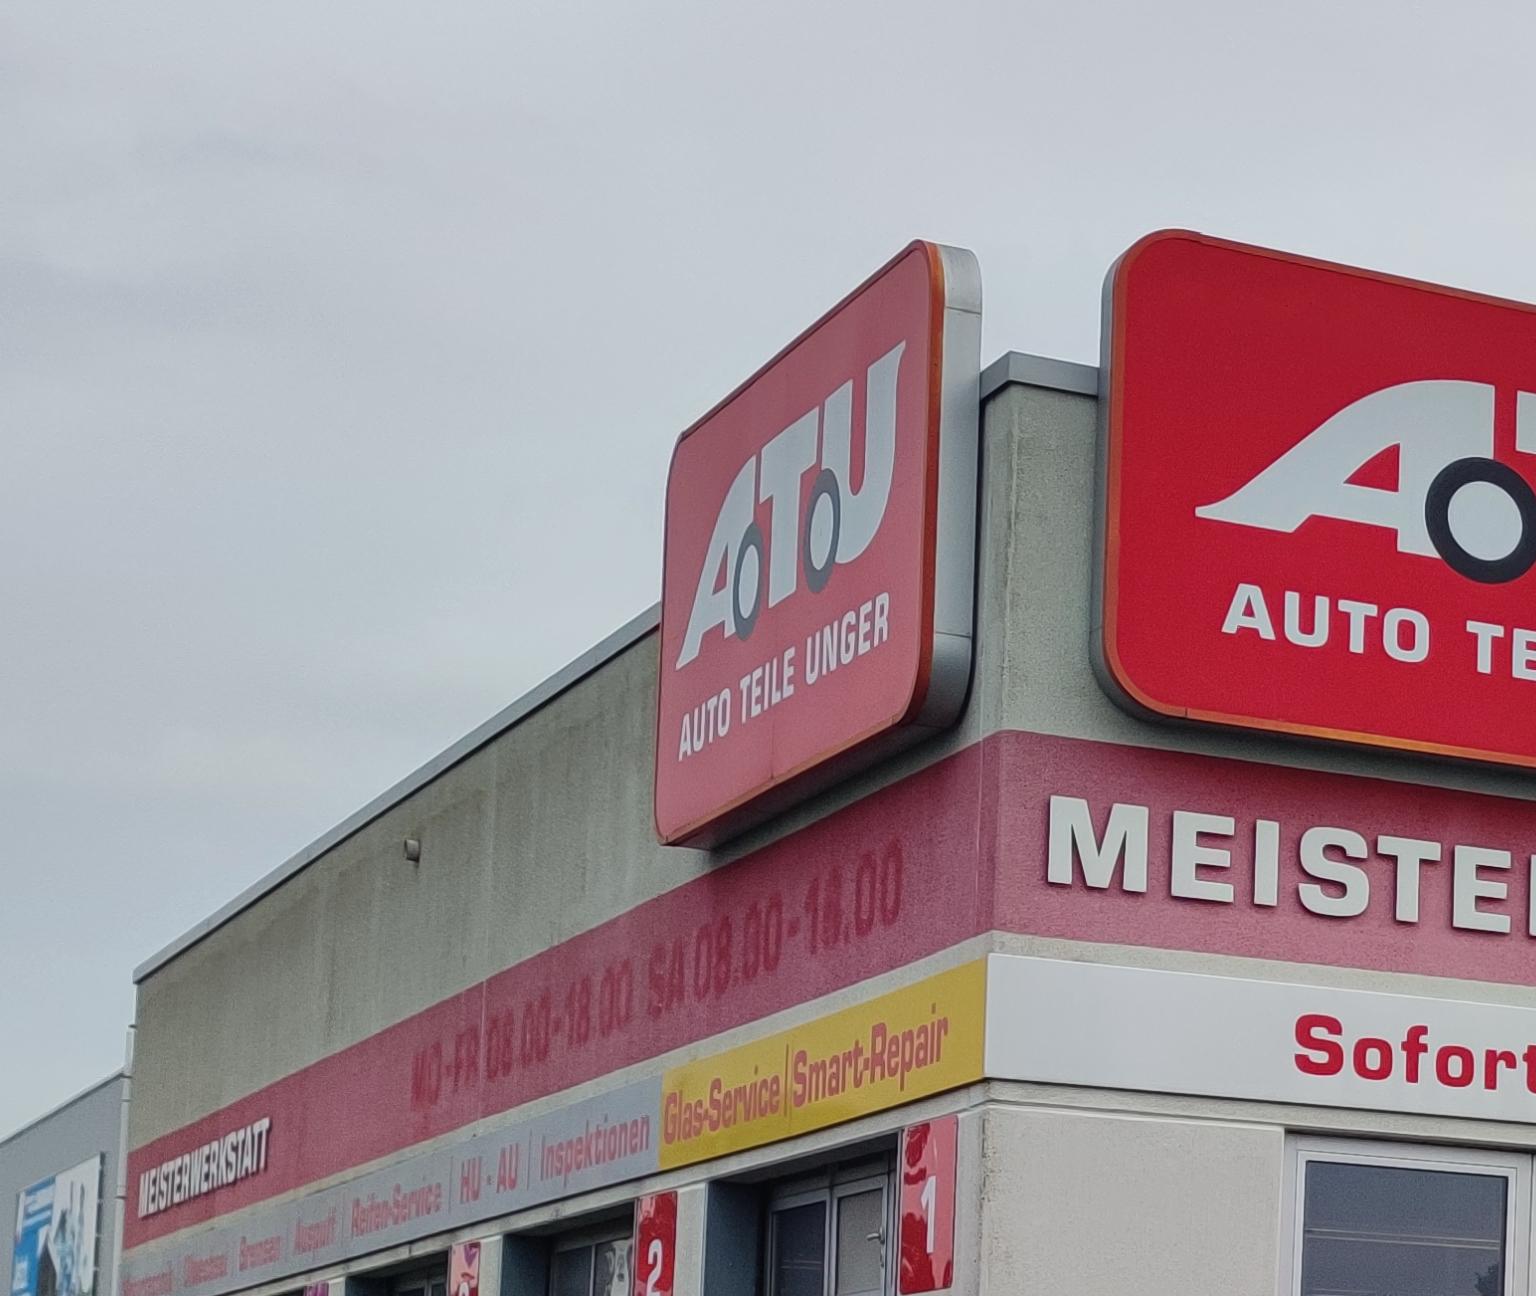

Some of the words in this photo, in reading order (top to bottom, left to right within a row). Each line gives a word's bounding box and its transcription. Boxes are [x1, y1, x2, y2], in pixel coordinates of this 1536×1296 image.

[1222, 583, 1429, 664] AUTO
[678, 689, 731, 762] AUTO
[741, 645, 795, 724] TEILE
[806, 592, 890, 685] UNGER
[663, 1065, 781, 1146] Glas-Service
[793, 1002, 949, 1108] Smart-Repair
[138, 1117, 271, 1219] MEISTERWERKSTATT
[460, 1157, 481, 1204] HU
[496, 1143, 519, 1194] AU
[540, 1113, 650, 1188] Inspektionen
[920, 1175, 938, 1254] 1
